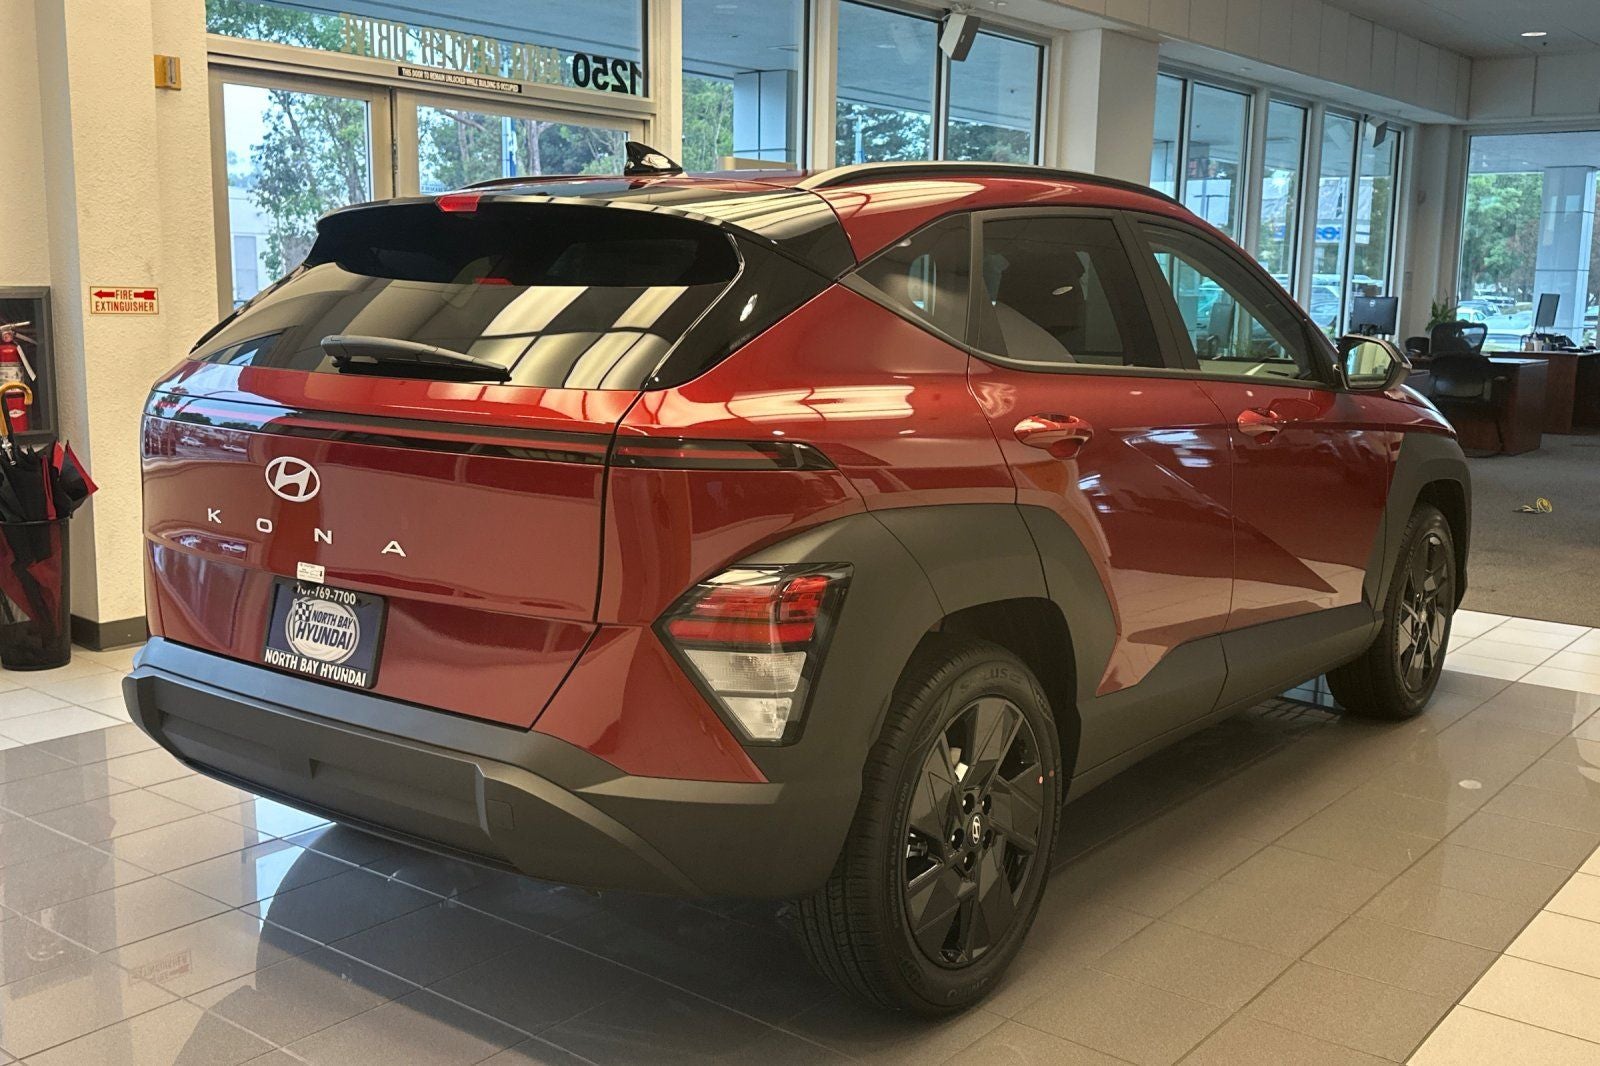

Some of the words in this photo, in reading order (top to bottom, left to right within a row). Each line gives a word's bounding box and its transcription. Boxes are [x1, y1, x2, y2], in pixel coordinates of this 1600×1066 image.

[95, 301, 154, 312] EXTINGUISHER
[116, 289, 133, 300] FIRE
[207, 508, 406, 558] KONA
[311, 610, 338, 626] NORTH
[337, 614, 354, 630] BAY
[296, 621, 353, 650] HYUNDAI
[264, 648, 298, 669] NORTH
[299, 658, 319, 675] BAY
[320, 663, 367, 687] HYUNDAI
